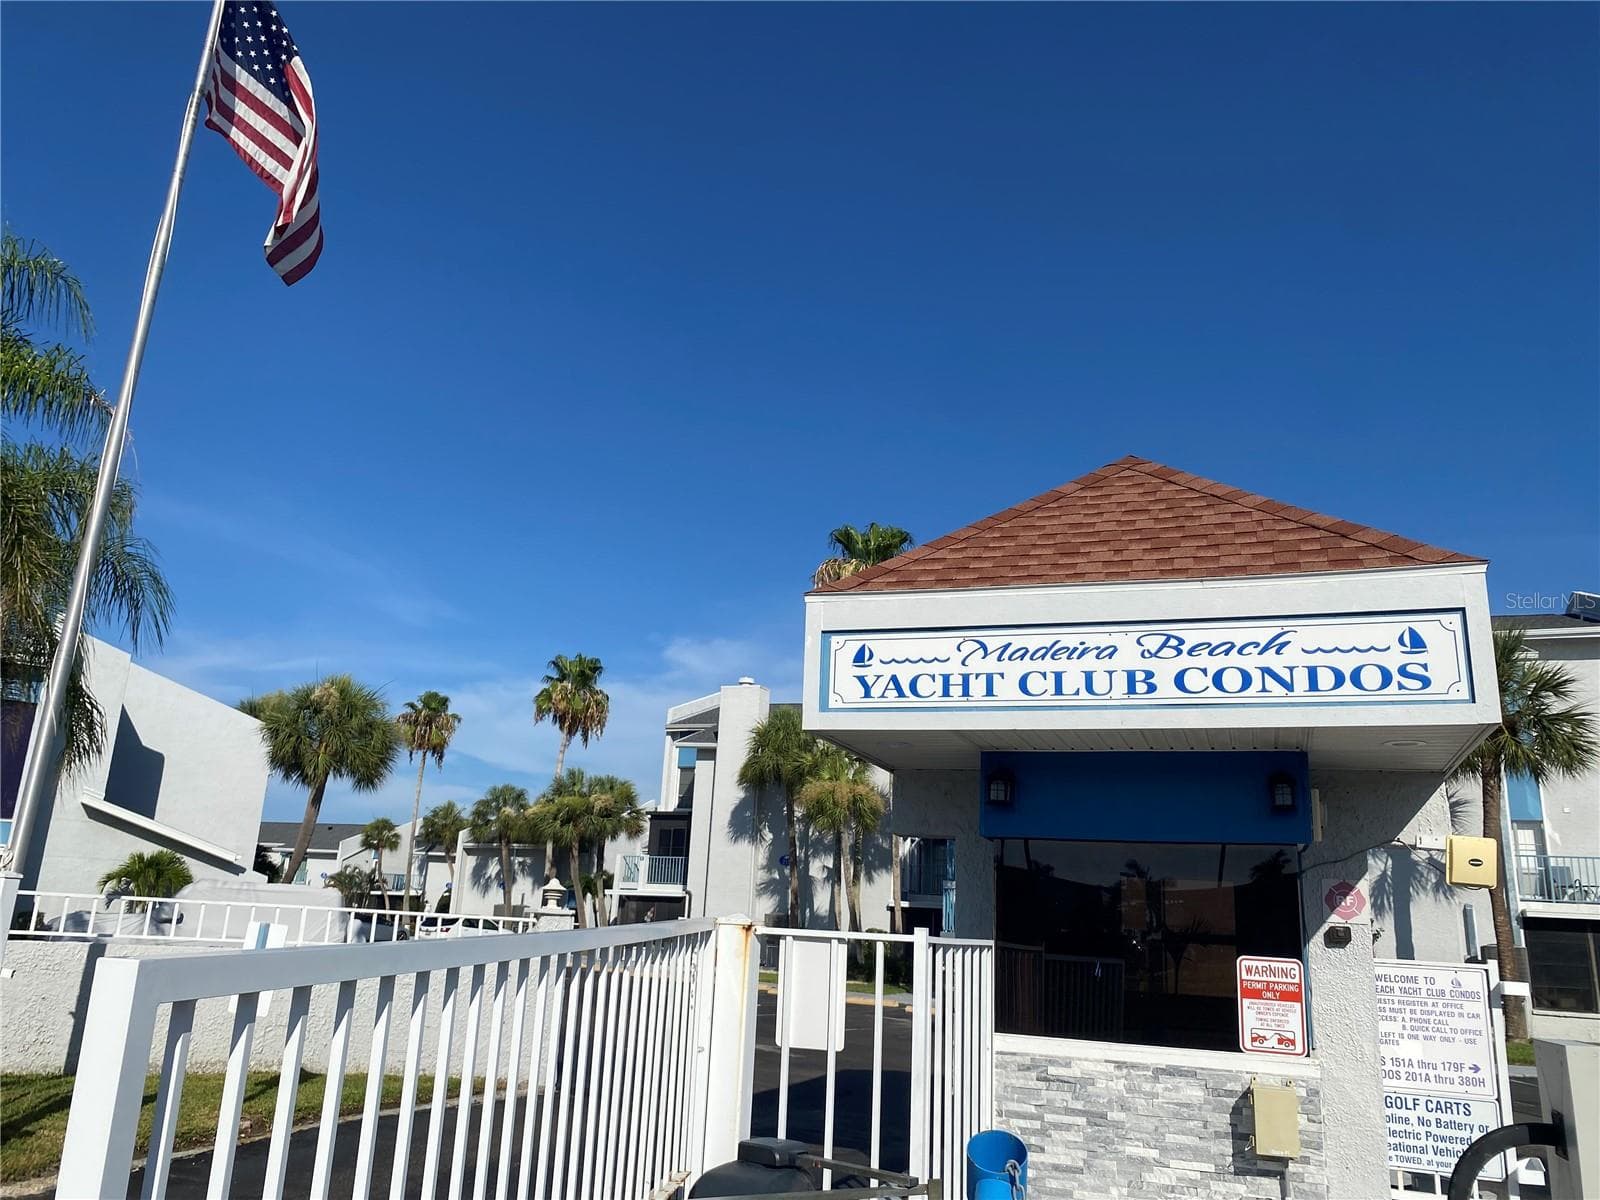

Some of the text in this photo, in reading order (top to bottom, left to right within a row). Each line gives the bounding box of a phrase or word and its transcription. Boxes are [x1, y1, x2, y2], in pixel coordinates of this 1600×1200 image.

[956, 629, 1298, 667] Madeira Beach
[853, 662, 1432, 699] YACHT CLUB CONDOS
[1244, 964, 1297, 980] WARNING
[1375, 973, 1436, 986] WELCOME TO
[1242, 980, 1299, 993] PERMIT PARKING
[1376, 985, 1481, 1000] EACH YACHT CLUB CONDOS
[1261, 990, 1280, 1000] ONLY
[1397, 999, 1429, 1007] REGISTER
[1442, 1002, 1464, 1010] OFFICE
[1389, 1007, 1407, 1015] MUST
[1409, 1008, 1417, 1016] BE
[1420, 1009, 1456, 1018] DISPLAYED
[1409, 1017, 1432, 1025] PHONE
[1433, 1018, 1449, 1026] CALL
[1398, 1032, 1405, 1040] IS
[1407, 1033, 1420, 1041] ONE
[1423, 1034, 1437, 1042] WAY
[1410, 1024, 1430, 1033] QUICK
[1431, 1026, 1448, 1034] CALL
[1449, 1027, 1459, 1035] TO
[1460, 1028, 1483, 1037] OFFICE
[1390, 1056, 1414, 1069] 151A
[1417, 1059, 1438, 1071] thru
[1441, 1061, 1466, 1073] 179F
[1405, 1071, 1431, 1083] 201A
[1434, 1073, 1455, 1085] thru
[1458, 1075, 1486, 1088] 380H
[1384, 1095, 1472, 1117] GOLF CARTS
[1417, 1115, 1432, 1128] No
[1435, 1117, 1475, 1134] Battery
[1478, 1124, 1490, 1134] or
[1388, 1127, 1473, 1147] lectric Powered
[1388, 1142, 1429, 1155] eational
[1426, 1159, 1434, 1167] at
[1435, 1160, 1452, 1169] your
